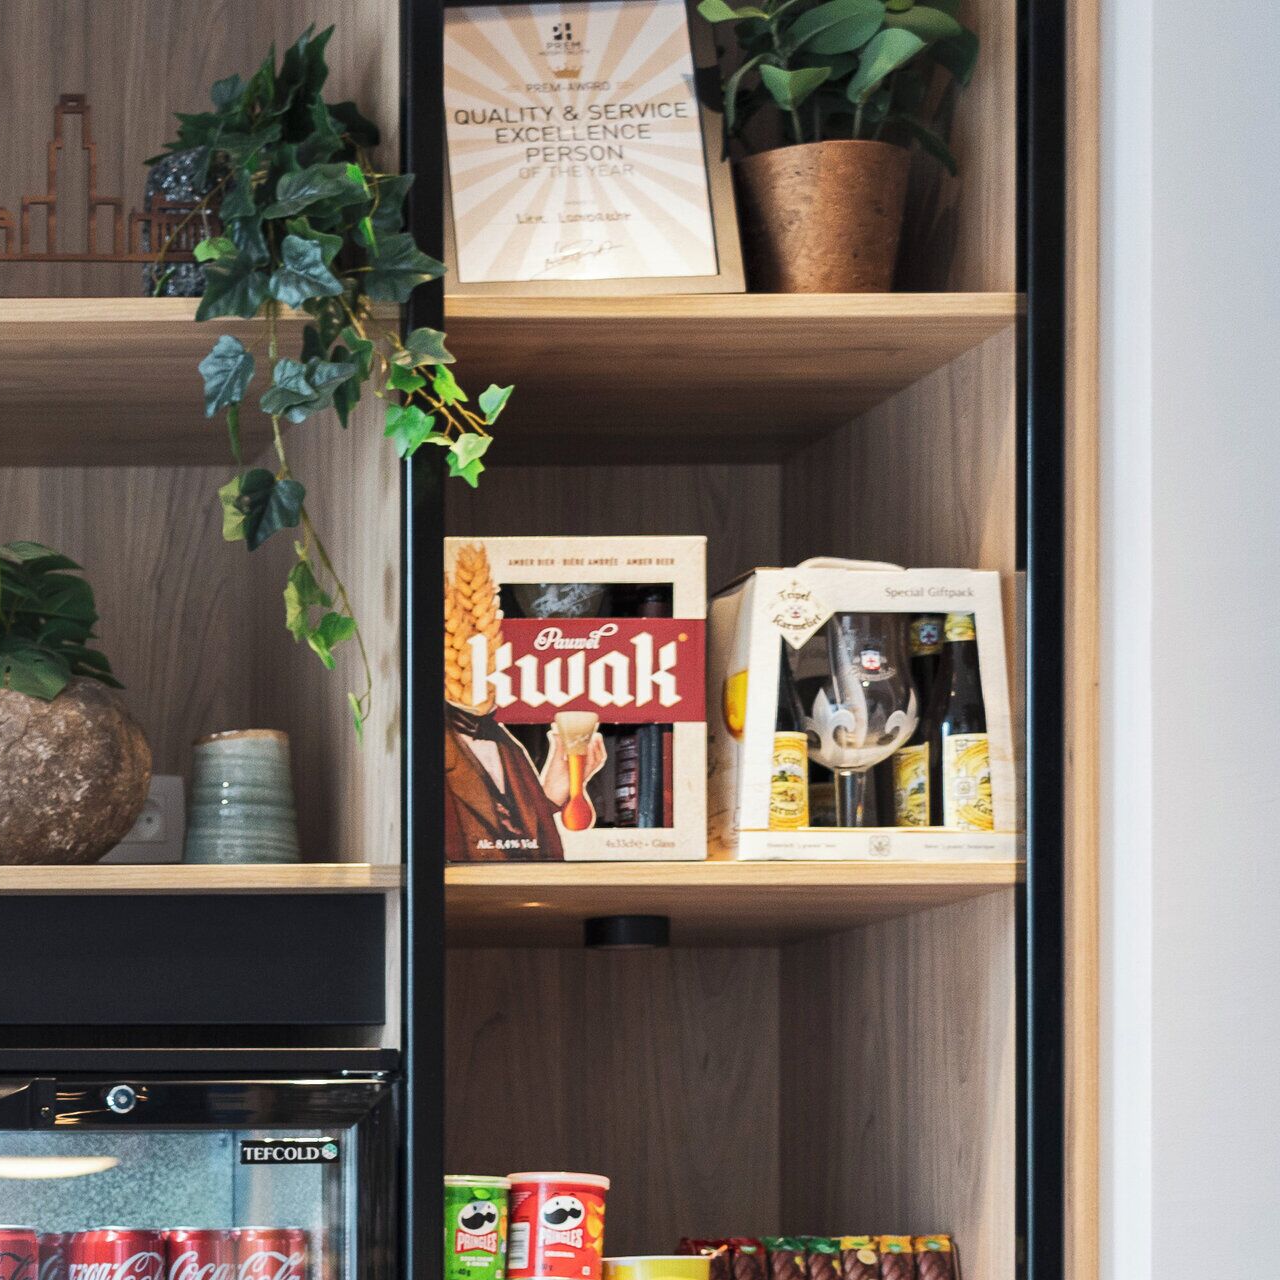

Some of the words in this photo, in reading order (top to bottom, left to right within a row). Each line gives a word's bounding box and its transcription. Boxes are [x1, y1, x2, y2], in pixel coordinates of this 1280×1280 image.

[454, 105, 553, 125] QUALITY
[563, 104, 578, 120] &
[588, 102, 688, 120] SERVICE
[495, 123, 651, 144] EXCELLENCE
[526, 145, 624, 163] PERSON
[519, 167, 539, 180] OF
[547, 165, 583, 178] THE
[588, 164, 634, 177] YEAR
[627, 557, 653, 566] AMBER
[656, 557, 676, 566] BEER
[885, 586, 924, 599] Special
[928, 586, 975, 600] Giftpack
[534, 623, 619, 650] Pauwel
[243, 1147, 320, 1160] TEFCOLD
[456, 1231, 497, 1253] PRINGLES
